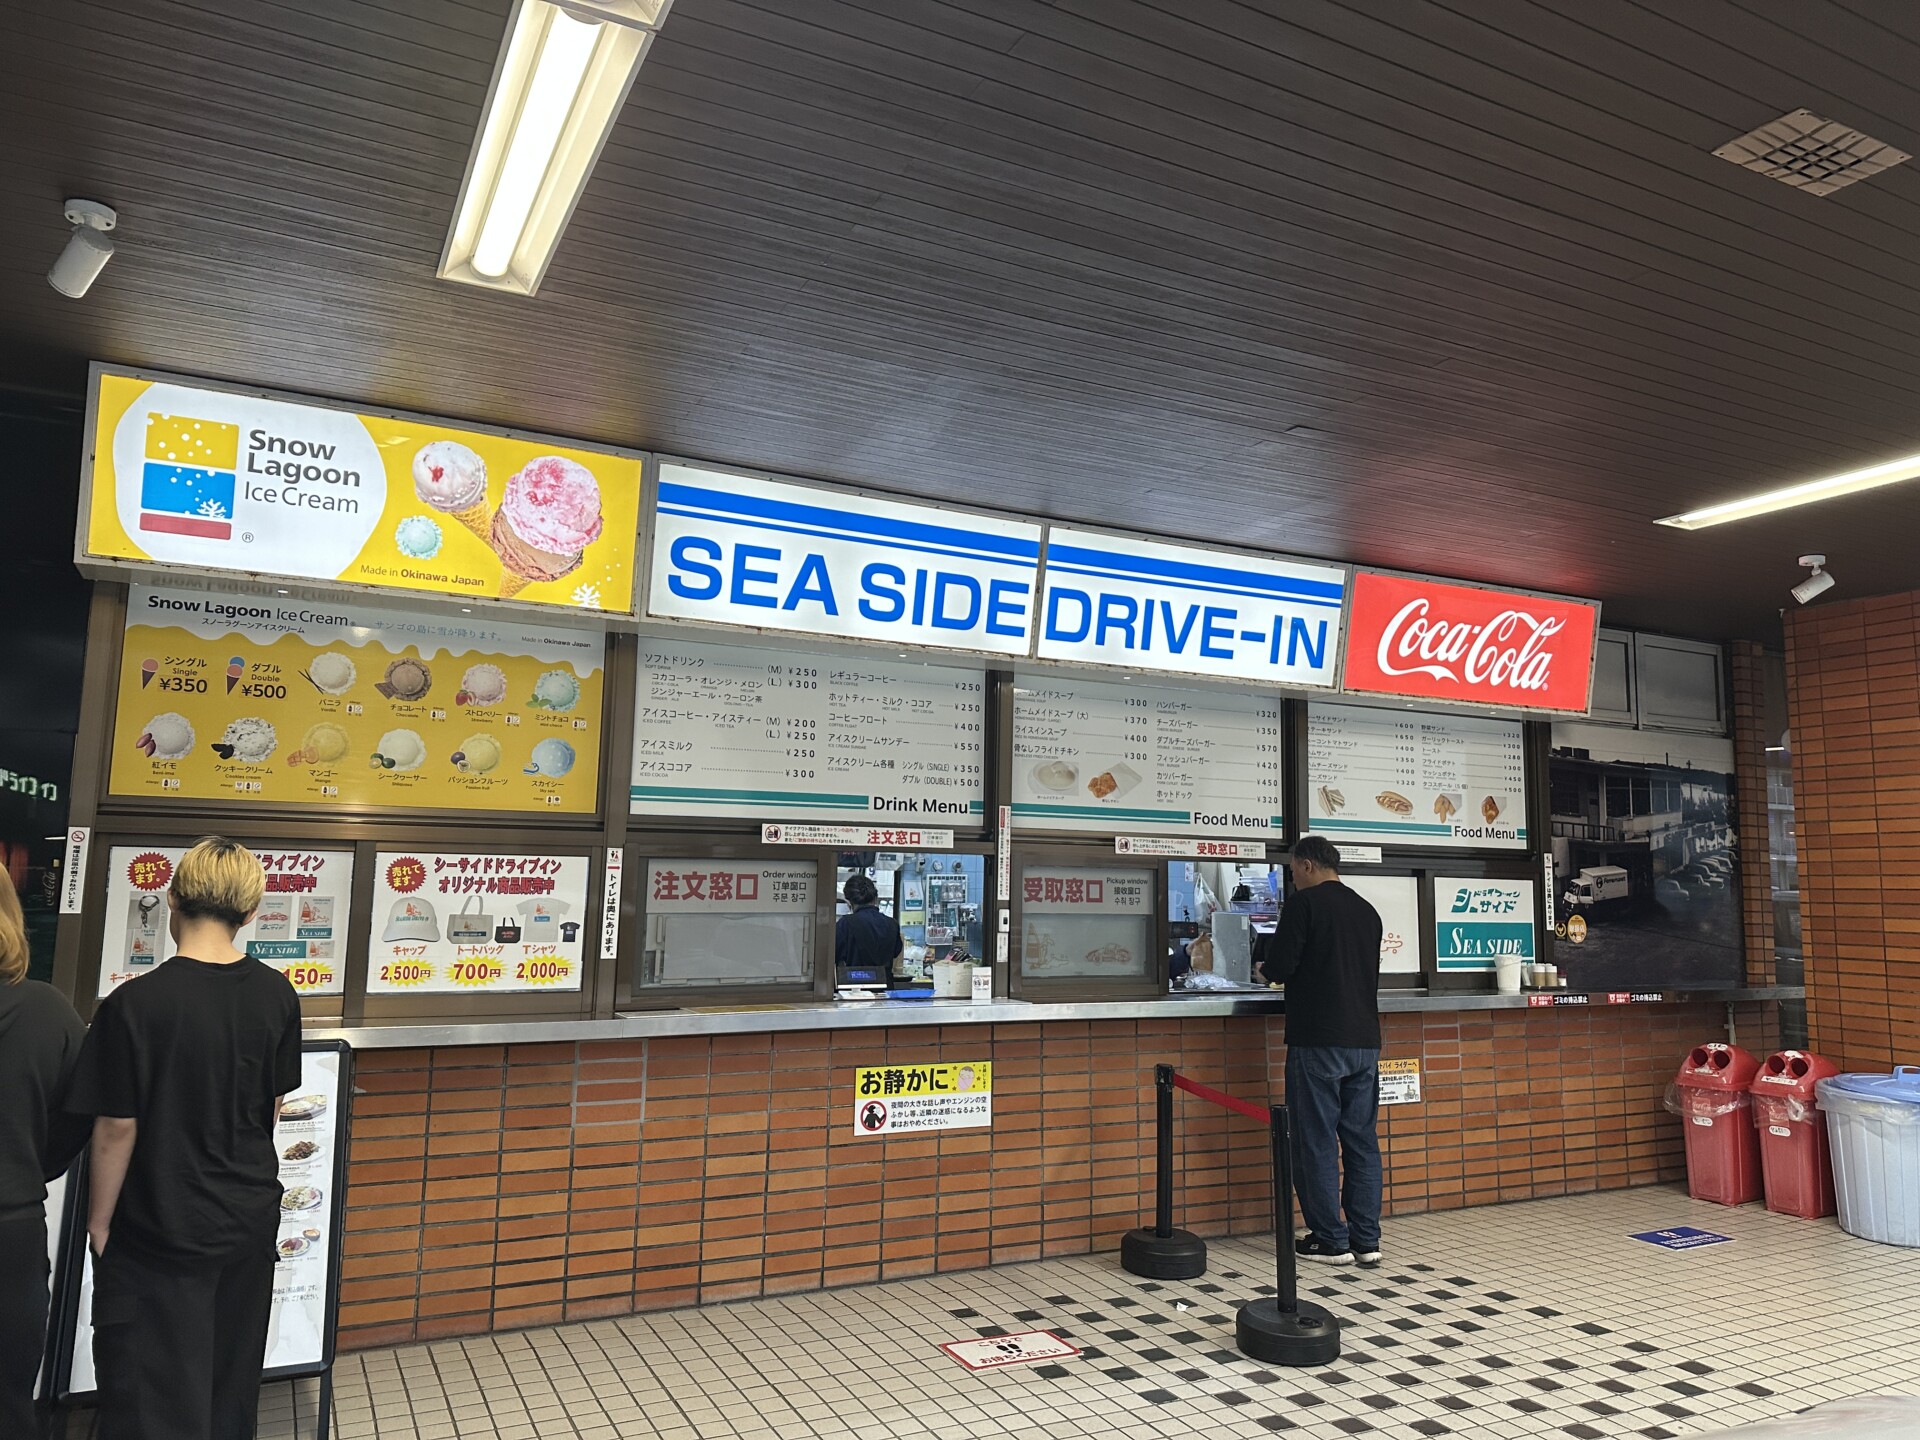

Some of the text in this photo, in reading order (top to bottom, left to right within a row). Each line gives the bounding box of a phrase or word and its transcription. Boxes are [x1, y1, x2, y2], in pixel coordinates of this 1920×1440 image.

[249, 429, 336, 460] Snow
[247, 452, 360, 487] Lagoon
[245, 482, 359, 513] Ice Cream
[361, 565, 484, 587] Made in Okinawa Japan
[668, 536, 1030, 638] SEA SIDE
[148, 595, 348, 626] Snow Lagoon Ice Cream
[202, 617, 304, 633] スノーラグーンアイスクリーム
[375, 621, 501, 641] サンゴの島に雪が降ります。
[1044, 585, 1328, 669] DRIVE-IN
[544, 638, 591, 648] Okinawa Japan
[1378, 598, 1567, 690] Coca-Cola
[164, 656, 207, 668] シングル
[251, 663, 282, 674] ダブル
[645, 654, 704, 667] ソフトドリンク
[788, 667, 817, 677] ¥250
[172, 667, 197, 676] Single
[251, 674, 280, 683] Double
[159, 678, 208, 694] ¥350
[788, 679, 817, 689] ¥300
[830, 670, 980, 691] レギュラーコーヒー ¥250
[242, 684, 286, 699] ¥500
[651, 687, 762, 703] ジンジャーエール・ウーロン茶
[390, 704, 427, 713] チョコレート
[829, 693, 980, 712] ホットティー・ミルク・ココア ¥250
[1157, 701, 1192, 710] ハンバーガー
[465, 709, 502, 717] ストロベリー
[535, 713, 569, 723] ミントチョコ
[642, 707, 761, 724] アイスコーヒー・アイスティー
[787, 719, 816, 728] ¥200
[1125, 716, 1147, 724] ¥370
[828, 713, 980, 731] コーヒーフロート ¥400
[1157, 719, 1198, 728] チーズバーガー
[787, 731, 816, 740] ¥250
[1015, 725, 1067, 736] ライスインスープ
[828, 734, 979, 751] アイスクリームサンデー ¥550
[1157, 736, 1216, 747] ダブルチーズバーガー
[1421, 736, 1464, 744] ガーリックトースト
[641, 739, 815, 758] アイスミルク ¥250
[1014, 744, 1147, 760] 骨なしフライドチキン ¥300
[152, 761, 177, 770] 紅イモ
[827, 757, 895, 769] アイスクリーム各種
[902, 761, 924, 770] シングル
[954, 764, 979, 773] ¥350
[1157, 755, 1210, 764] フィッシュバーガー
[214, 764, 273, 774] クッキークリーム
[309, 769, 338, 777] マンゴー
[640, 761, 814, 778] アイスココア ¥300
[448, 776, 508, 785] パッションフルーツ
[902, 775, 920, 784] ダブル
[954, 778, 979, 787] ¥500
[1157, 772, 1192, 781] カツバーガー
[873, 796, 968, 814] Drink Menu
[1194, 812, 1268, 827] Food Menu
[867, 830, 921, 845] 注文窓口
[1454, 826, 1515, 839] Food Menu
[1197, 843, 1238, 855] 受取窓口
[134, 860, 166, 874] 売れて
[391, 864, 420, 877] 売れて
[434, 857, 562, 874] シーサイドドライブイン
[135, 872, 161, 884] ます。
[264, 873, 317, 892] 品販売中
[392, 875, 416, 887] ます。
[439, 876, 555, 894] オリジナル商品販売中
[653, 870, 758, 900] 注文窓口
[1106, 877, 1126, 885] Pickup
[773, 893, 806, 902] 주문 창구
[1024, 878, 1103, 903] 受取窓口
[604, 874, 616, 956] トイレは奥にあります。
[1450, 927, 1522, 954] SEA SIDE
[253, 943, 273, 954] SEA
[393, 944, 556, 956] キャップ トートバッグ Tシャツ
[380, 962, 568, 981] 2,500円 700円 2,000円
[860, 1068, 948, 1095] お静かに
[891, 1096, 987, 1108] 夜間の大きな話し声やエンジンの空
[891, 1106, 987, 1118] ふかし等、近隣の迷惑になるような
[891, 1119, 948, 1128] 事はおやめください。
[978, 1347, 1061, 1364] お待ちください
